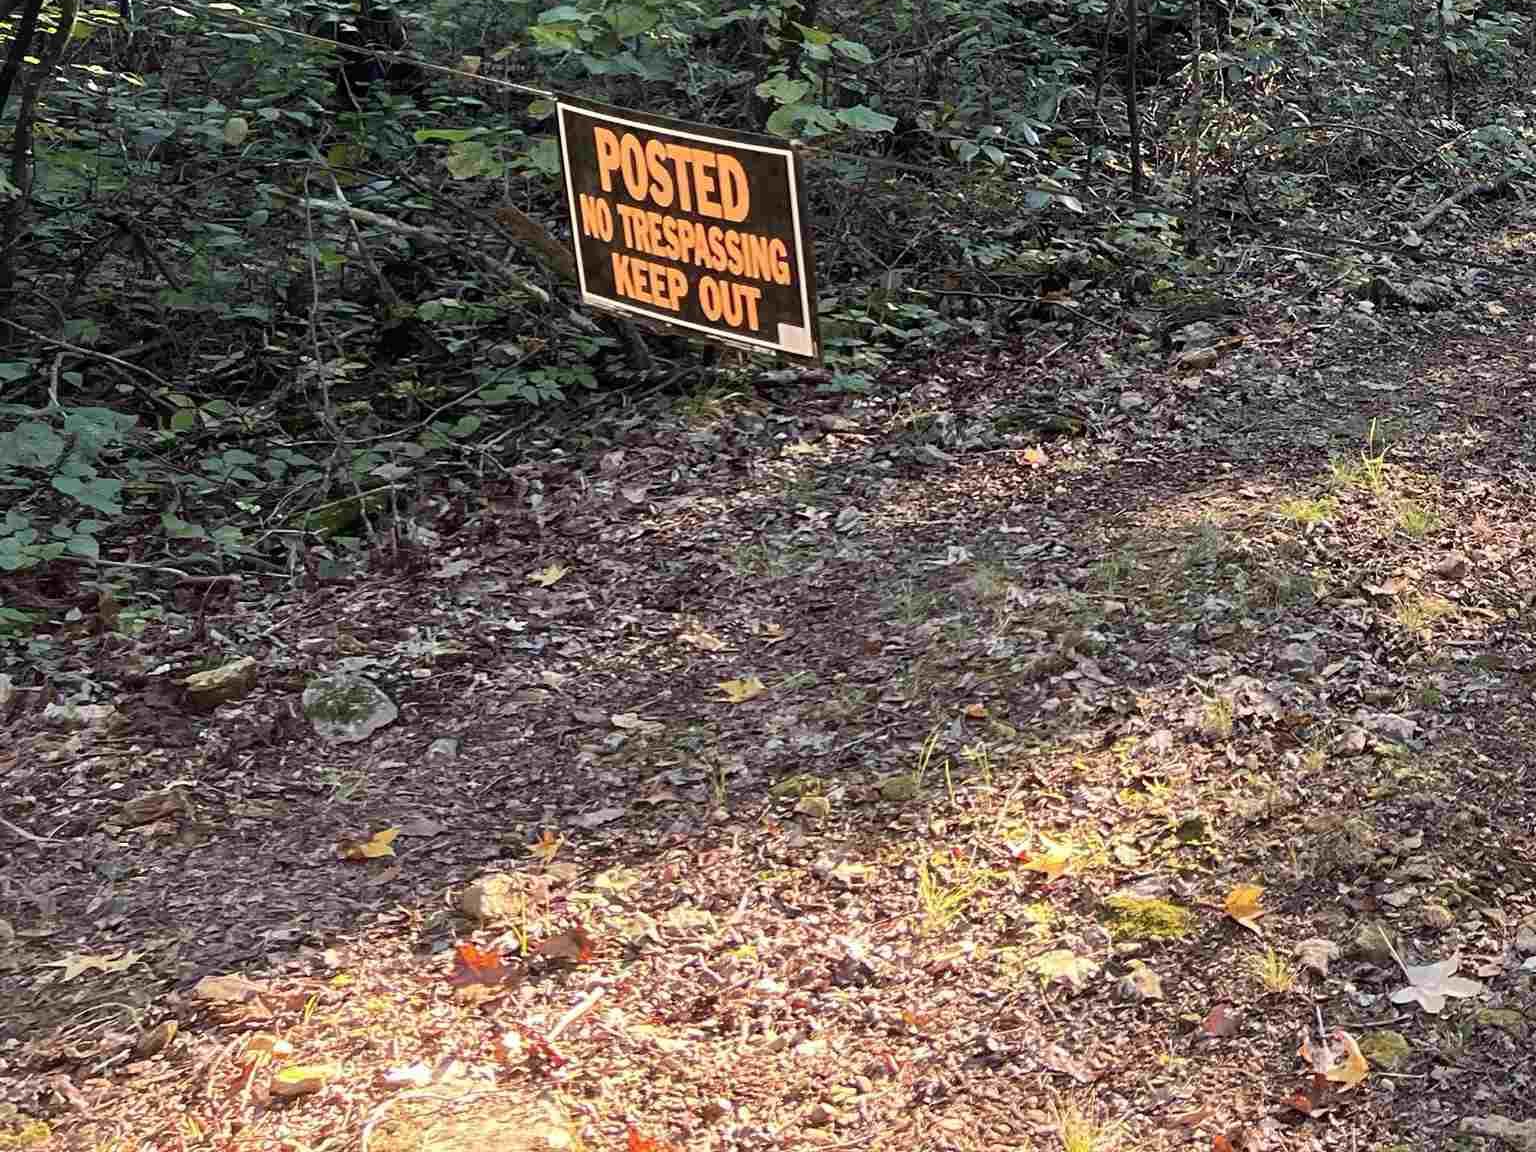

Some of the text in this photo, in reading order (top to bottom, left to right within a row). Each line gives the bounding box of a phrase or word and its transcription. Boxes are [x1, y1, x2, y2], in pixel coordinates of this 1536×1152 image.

[593, 126, 750, 223] POSTED
[579, 192, 792, 286] NO TRESPASSING
[611, 252, 763, 332] KEEP OUT
